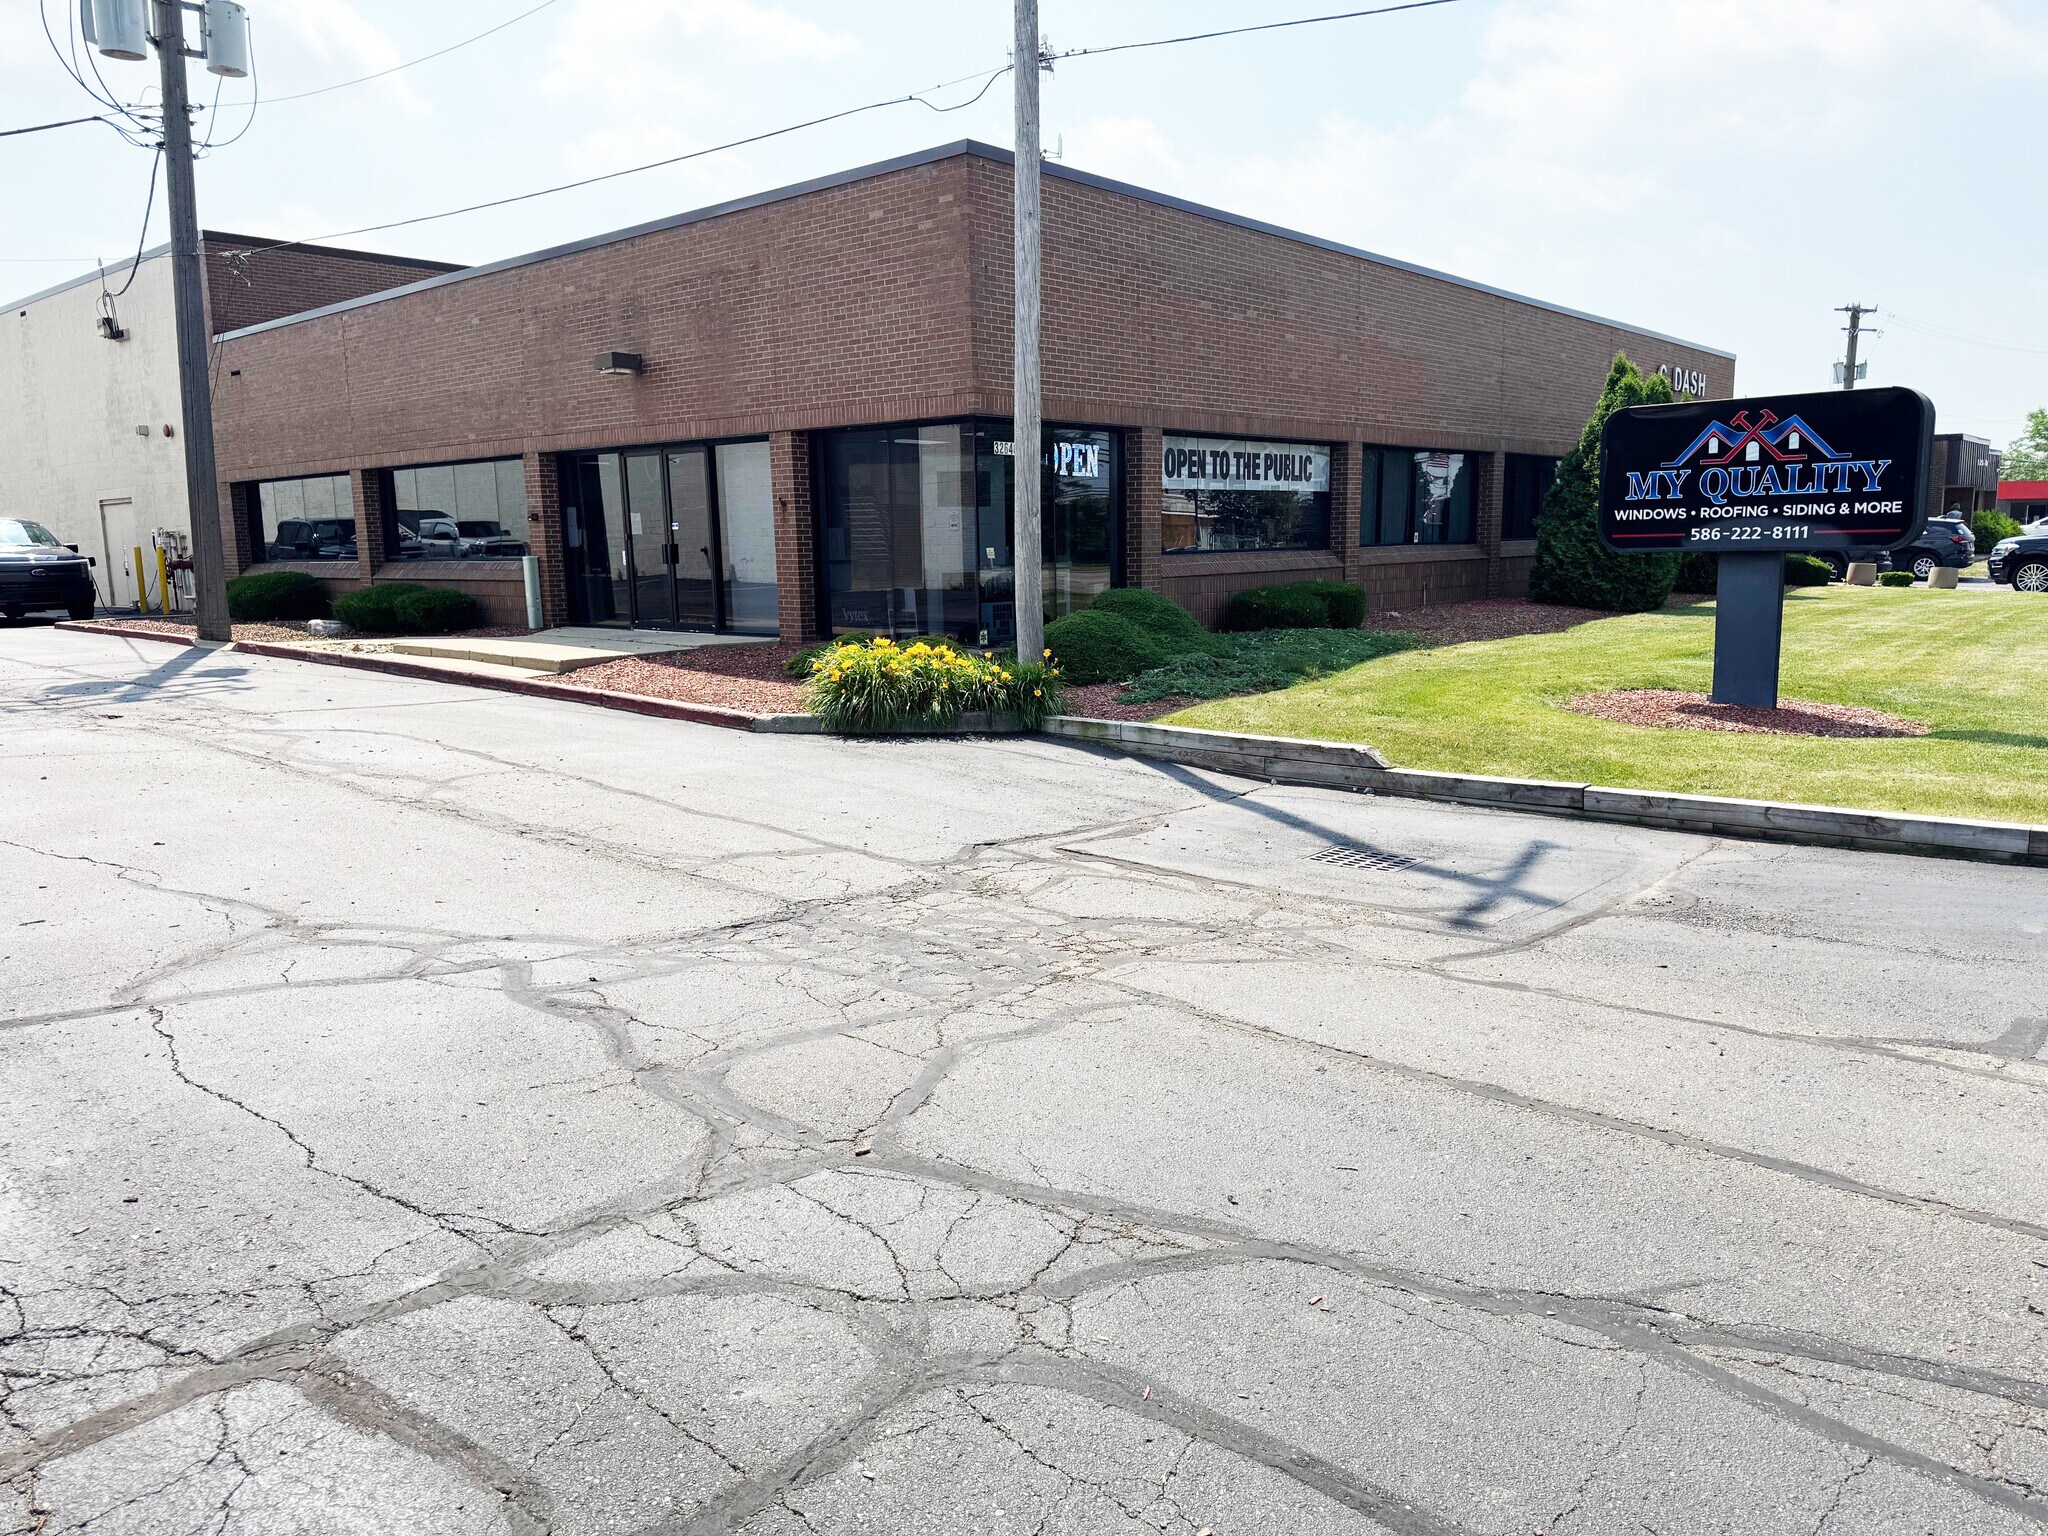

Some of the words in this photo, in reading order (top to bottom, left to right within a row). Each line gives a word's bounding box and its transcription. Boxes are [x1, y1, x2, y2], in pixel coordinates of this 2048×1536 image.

[1674, 366, 1706, 397] DASH
[994, 441, 1015, 455] 3264
[1164, 447, 1206, 479] OPEN
[1210, 450, 1230, 480] TO
[1233, 451, 1261, 481] THE
[1263, 453, 1313, 482] PUBLIC
[1625, 469, 1691, 500] MY
[1699, 460, 1892, 504] QUALITY
[1614, 508, 1687, 521] WINDOWS
[1700, 505, 1769, 518] ROOFING
[1782, 502, 1836, 516] SIDING
[1839, 503, 1850, 514] &
[1854, 501, 1903, 514] MORE
[1690, 525, 1809, 541] 586-222-8111
